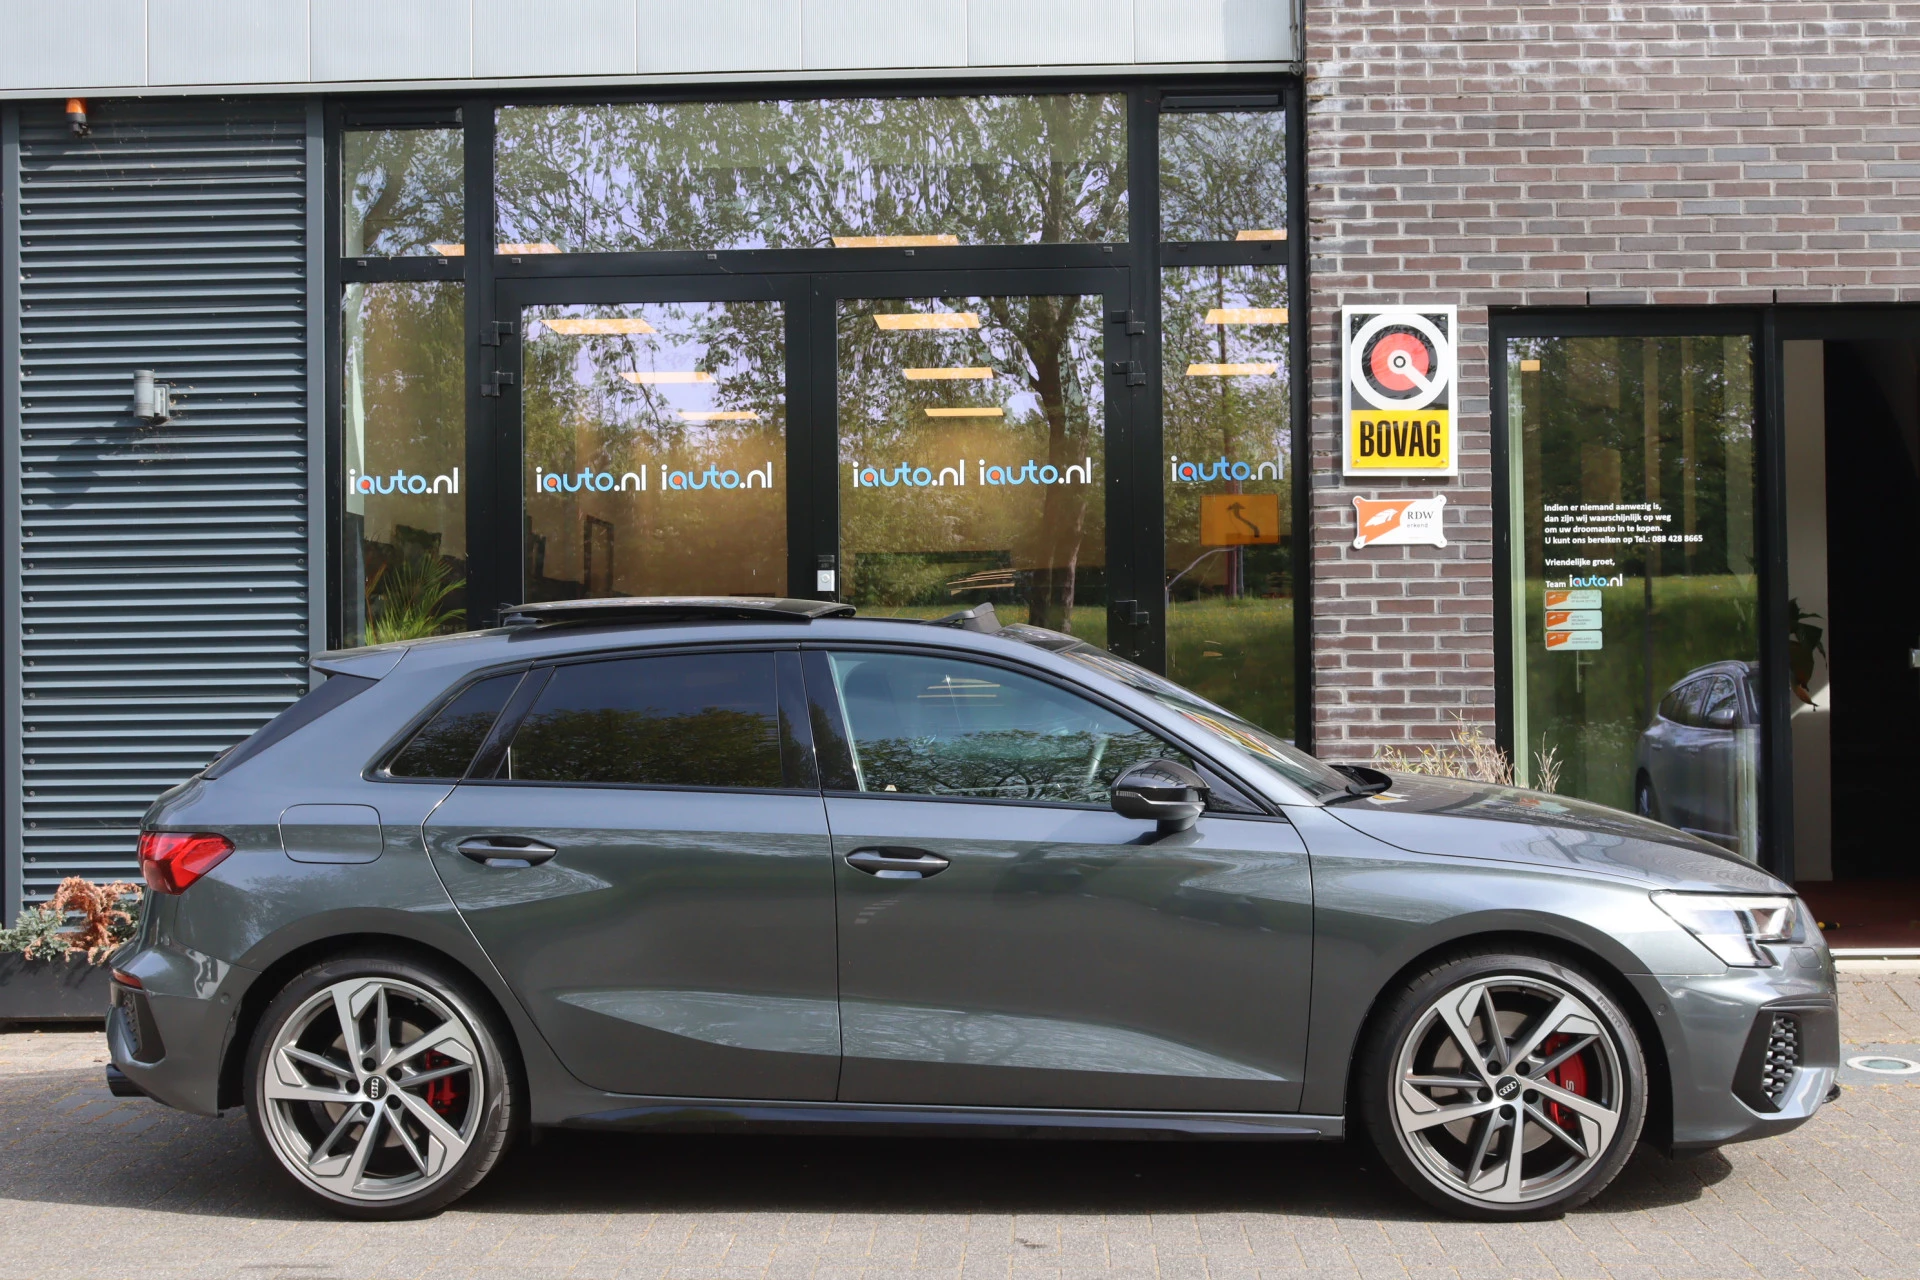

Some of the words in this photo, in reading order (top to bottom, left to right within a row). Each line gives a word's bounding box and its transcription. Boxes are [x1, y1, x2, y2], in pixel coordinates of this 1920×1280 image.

[1360, 419, 1441, 458] BOVAG
[852, 459, 965, 488] iauto.nl
[979, 457, 1092, 486] iauto.nl
[1171, 454, 1284, 482] iauto.nl
[349, 467, 459, 495] iauto.nl
[536, 464, 647, 493] iauto.nl
[661, 461, 773, 491] iauto.nl
[1544, 503, 1568, 512] Indien
[1570, 504, 1579, 512] er
[1580, 502, 1614, 512] niemand
[1616, 502, 1651, 512] aanwezig
[1653, 501, 1662, 511] is,
[1407, 511, 1434, 520] RDW
[1544, 514, 1559, 523] dan
[1561, 514, 1574, 524] zijn
[1576, 514, 1588, 524] wij
[1589, 513, 1642, 524] waarschijnlijk
[1643, 514, 1654, 523] op
[1655, 514, 1672, 523] weg
[1573, 525, 1616, 534] droomauto
[1617, 524, 1625, 533] in
[1627, 525, 1635, 533] te
[1636, 524, 1663, 533] kopen.
[1545, 536, 1551, 545] U
[1553, 536, 1570, 545] kunt
[1572, 537, 1586, 545] ons
[1587, 535, 1621, 544] bereiken
[1623, 536, 1633, 545] op
[1634, 535, 1650, 544] Tel.:
[1652, 534, 1667, 543] 088
[1668, 534, 1682, 543] 428
[1684, 534, 1704, 543] 8665
[1545, 557, 1591, 567] Vriendelijke
[1592, 558, 1616, 568] groet,
[1545, 580, 1567, 588] Team
[1569, 573, 1623, 588] iauto.nl
